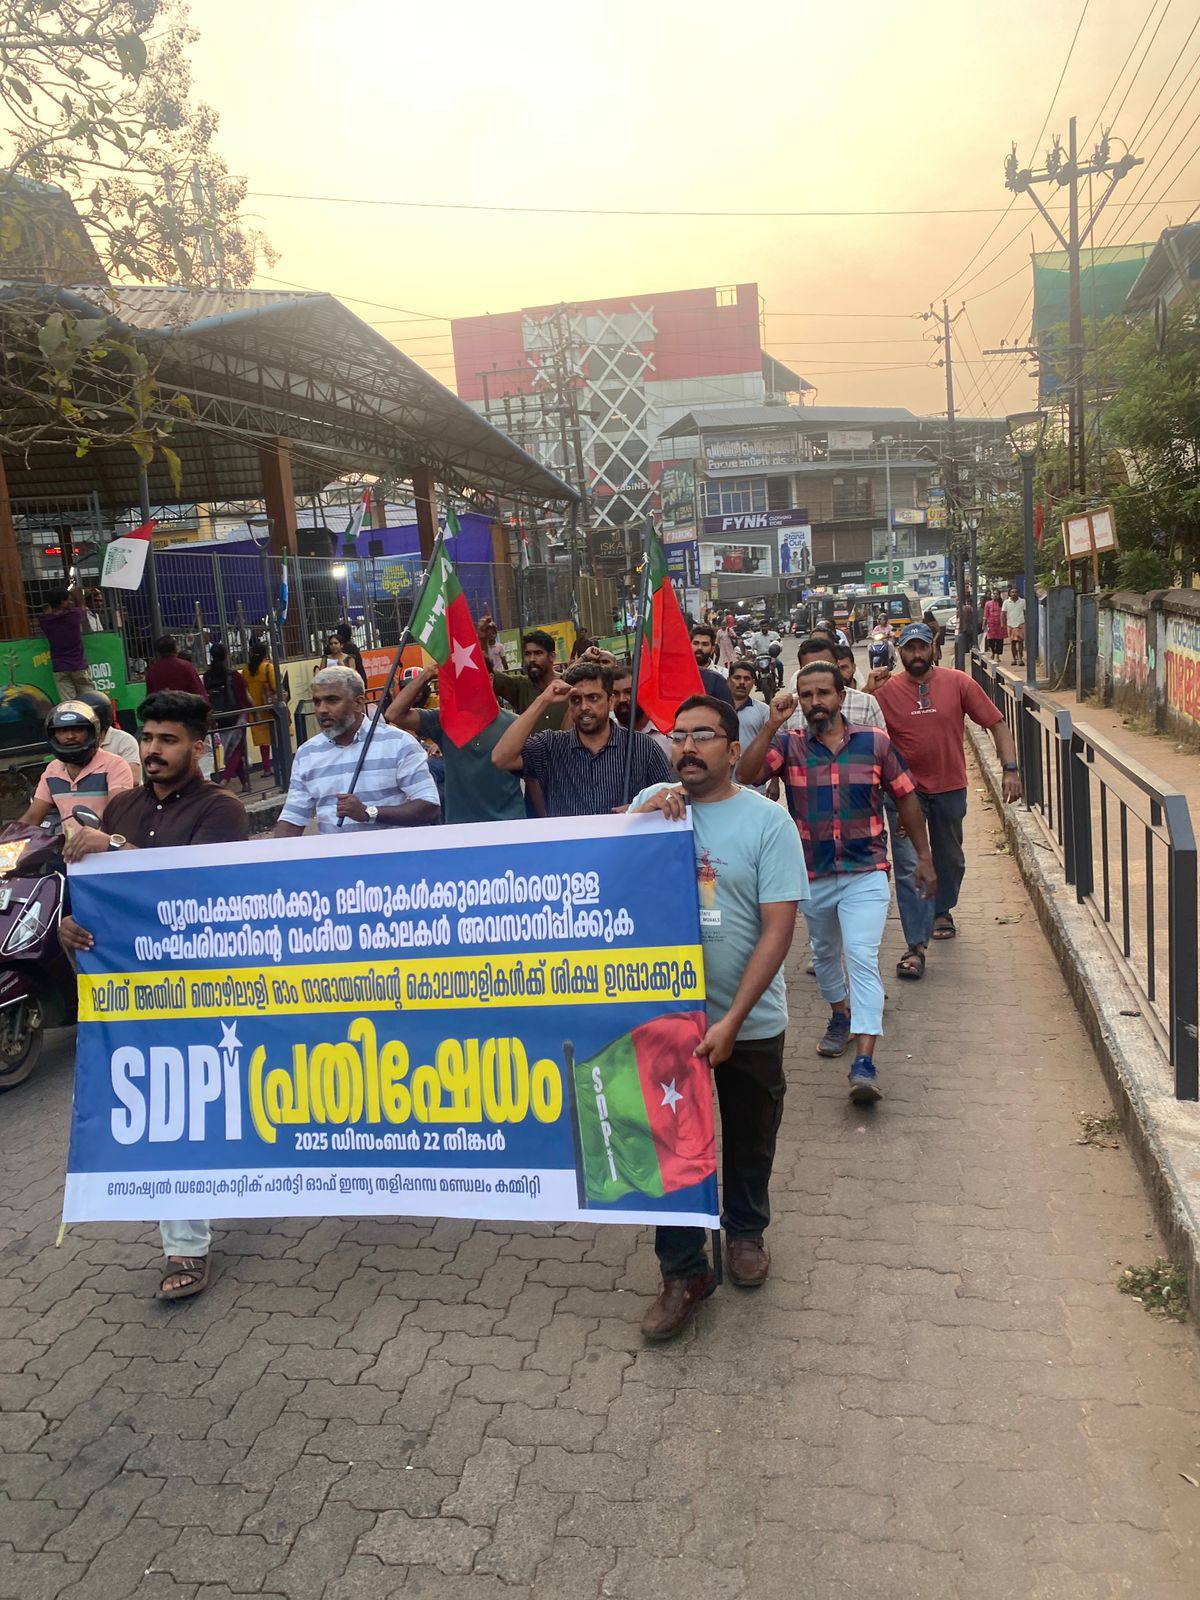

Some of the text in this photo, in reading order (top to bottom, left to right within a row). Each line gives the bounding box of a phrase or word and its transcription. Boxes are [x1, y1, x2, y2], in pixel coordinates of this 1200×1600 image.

[722, 514, 768, 531] FYNK
[784, 532, 805, 540] Stand
[868, 565, 900, 576] oppo
[913, 559, 937, 571] vivo
[157, 869, 600, 932] ന്യൂനപക്ഷങ്ങൾക്കും ദലിതുകൾക്കുമെതിരെയുള്ള
[134, 905, 634, 963] സംഘപരിവാറിന്റെ വംശീയ കൊലകൾ അവസാനിപ്പിക്കുക
[135, 976, 186, 1011] അതിഥി
[191, 973, 269, 1010] തൊഴിലാളി
[272, 979, 299, 1004] രാം
[407, 959, 547, 1003] കൊലയാളികൾക്ക്
[551, 958, 599, 995] ശിക്ഷ
[604, 959, 697, 999] ഉറപ്പാക്കുക
[110, 1020, 244, 1145] SDPI
[249, 1017, 563, 1144] പ്രതിഷേധം
[294, 1127, 506, 1151] 2025 ഡിസംബർ 22 തിങ്കൾ
[107, 1178, 172, 1199] സോഷ്യൽ
[264, 1173, 303, 1195] പാർട്ടി
[306, 1173, 337, 1192] ഓഫ്
[339, 1176, 374, 1195] ഇന്ത്യ
[375, 1174, 437, 1194] തളിപ്പറമ്പ
[439, 1178, 491, 1193] മണ്ഡലം
[494, 1175, 541, 1199] കമ്മിറ്റി
